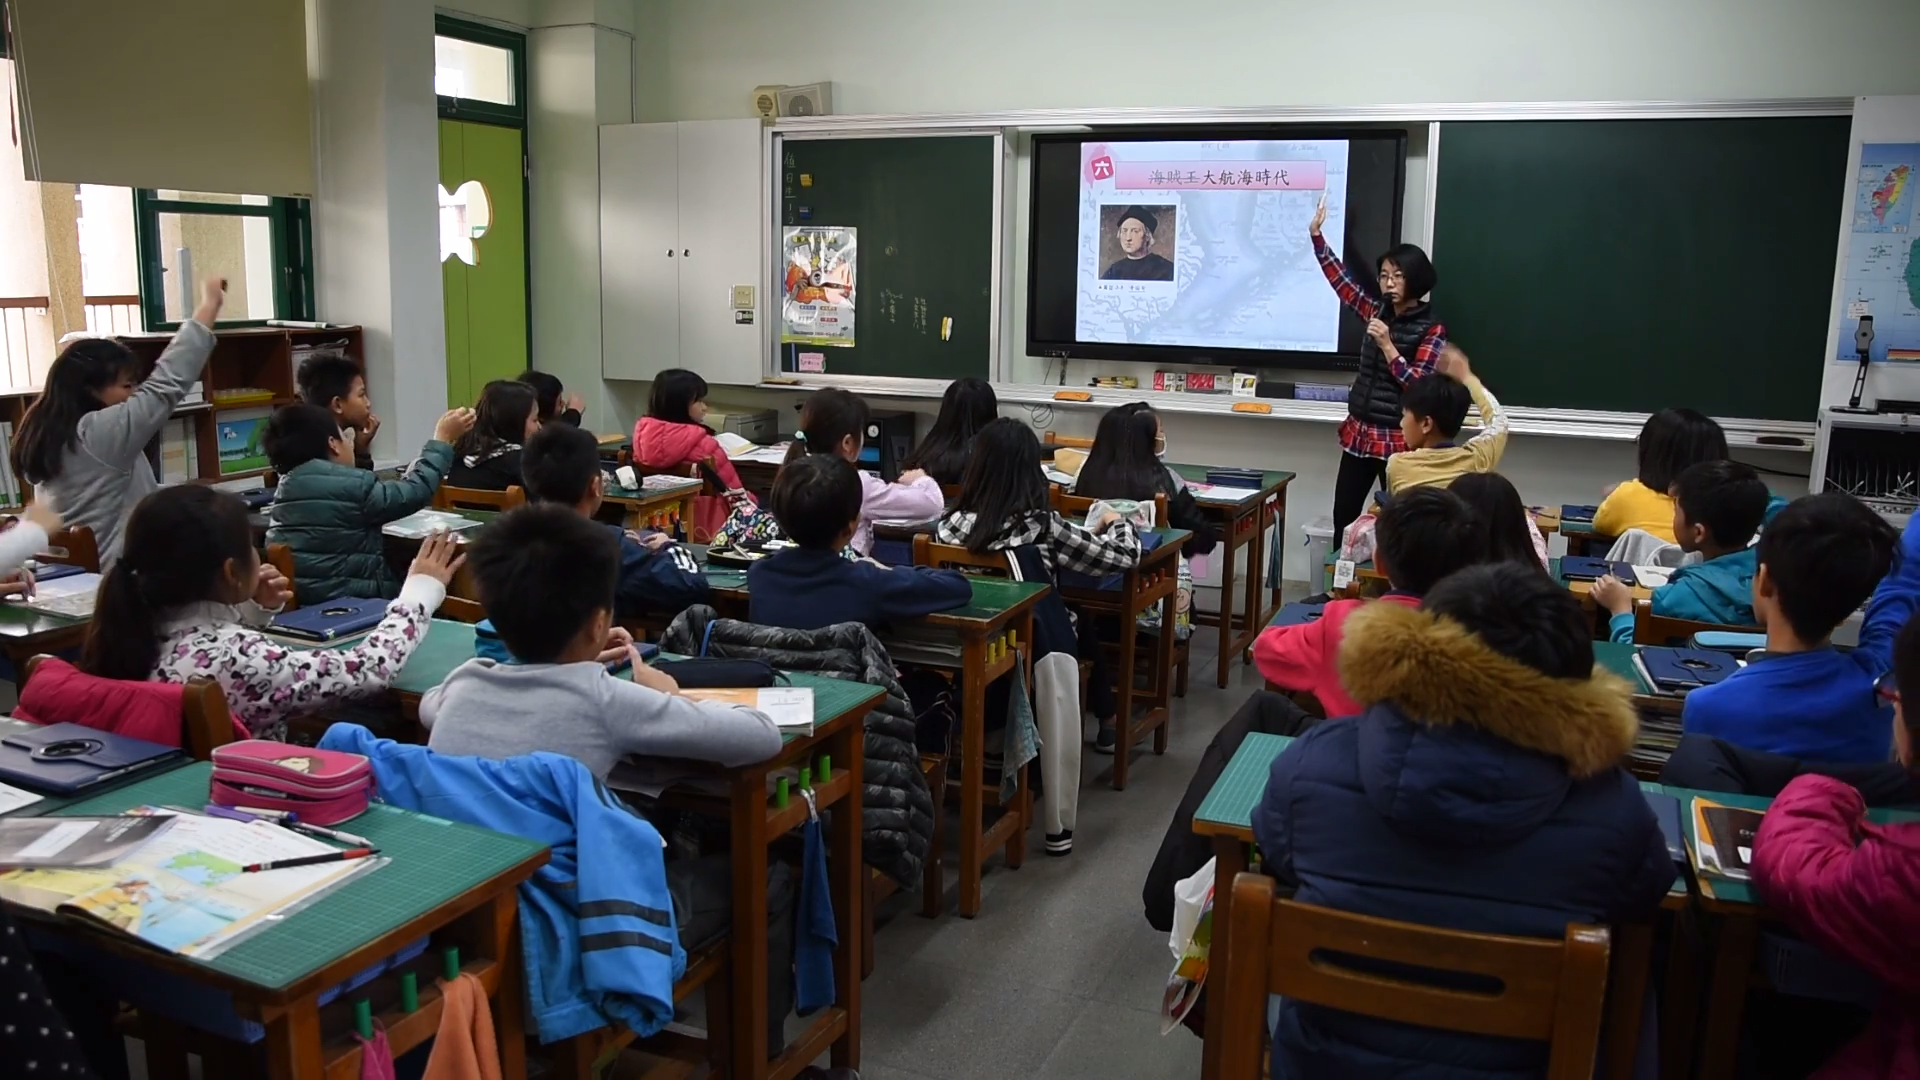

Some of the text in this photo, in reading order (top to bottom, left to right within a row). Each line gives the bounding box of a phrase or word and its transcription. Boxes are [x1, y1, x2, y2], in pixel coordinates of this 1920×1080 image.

[1094, 160, 1110, 176] 六
[1147, 168, 1290, 186] 海賊王大航海時代
